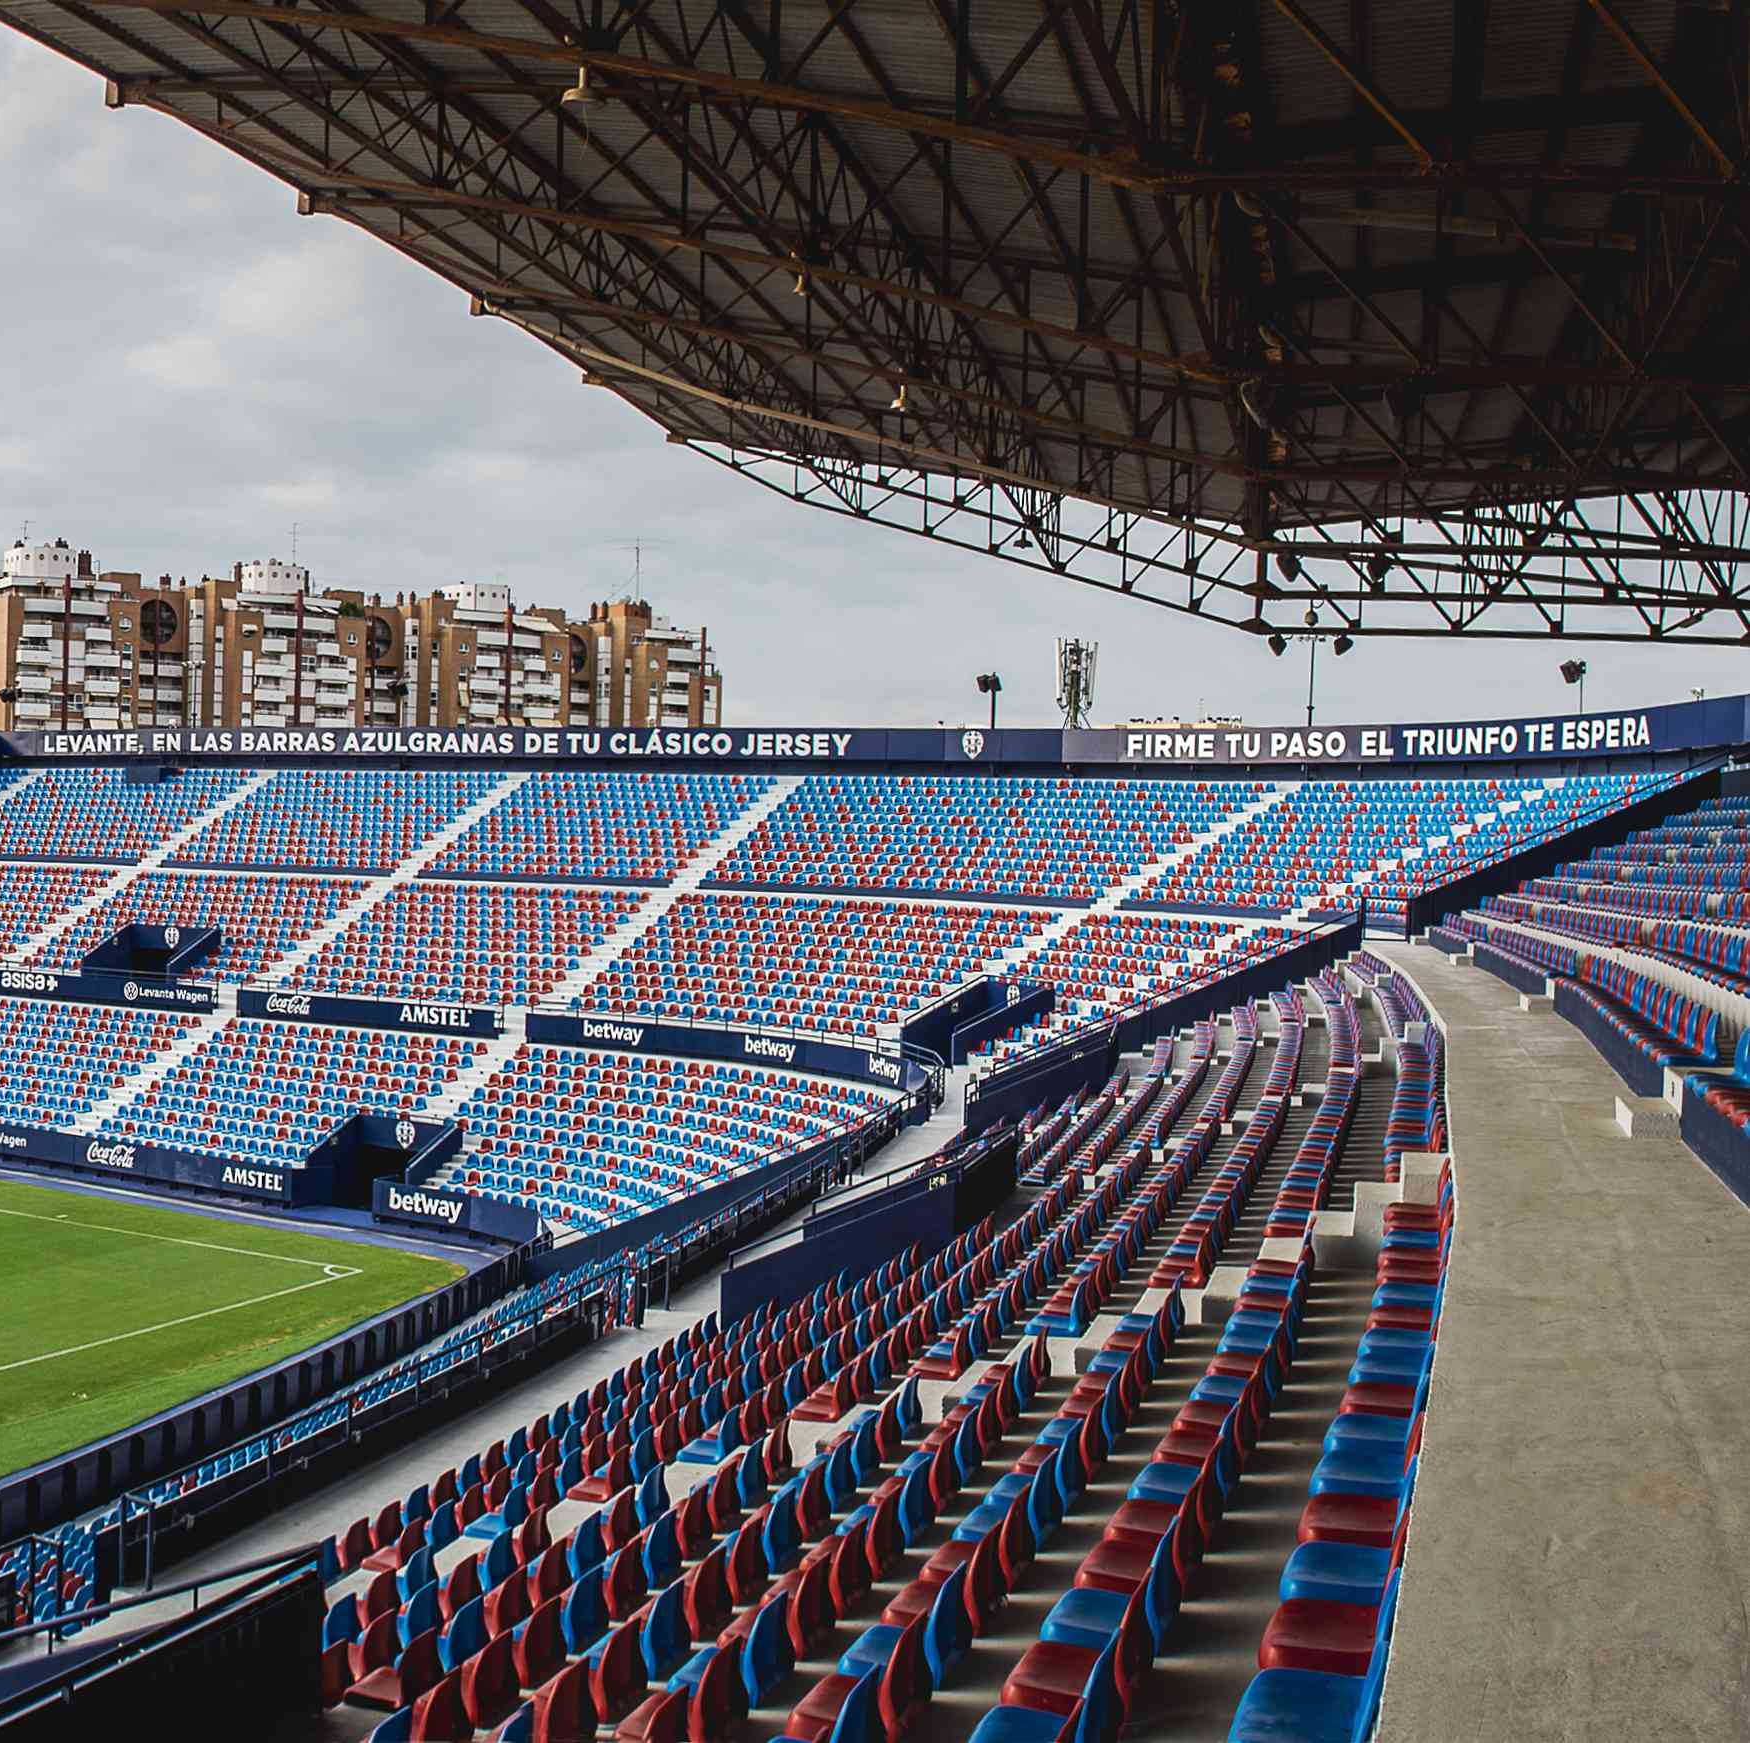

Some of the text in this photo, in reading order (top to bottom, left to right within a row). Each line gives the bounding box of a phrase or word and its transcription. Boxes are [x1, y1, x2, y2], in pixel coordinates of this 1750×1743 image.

[43, 729, 852, 756] LEVANTE, EN LAS BARRAS AZULGRANAS DE TU CLÁSICO JERSEY
[1127, 715, 1650, 758] FIRME TU PASO EL TRIUNFO TE ESPERA
[1, 971, 46, 990] asisa
[138, 986, 208, 1004] Levante Wagen
[399, 1004, 472, 1027] AMSTEL
[583, 1020, 644, 1045] betway
[744, 1035, 796, 1062] betway
[868, 1053, 901, 1080] betway
[222, 1166, 283, 1191] AMSTEL
[389, 1187, 463, 1223] betway
